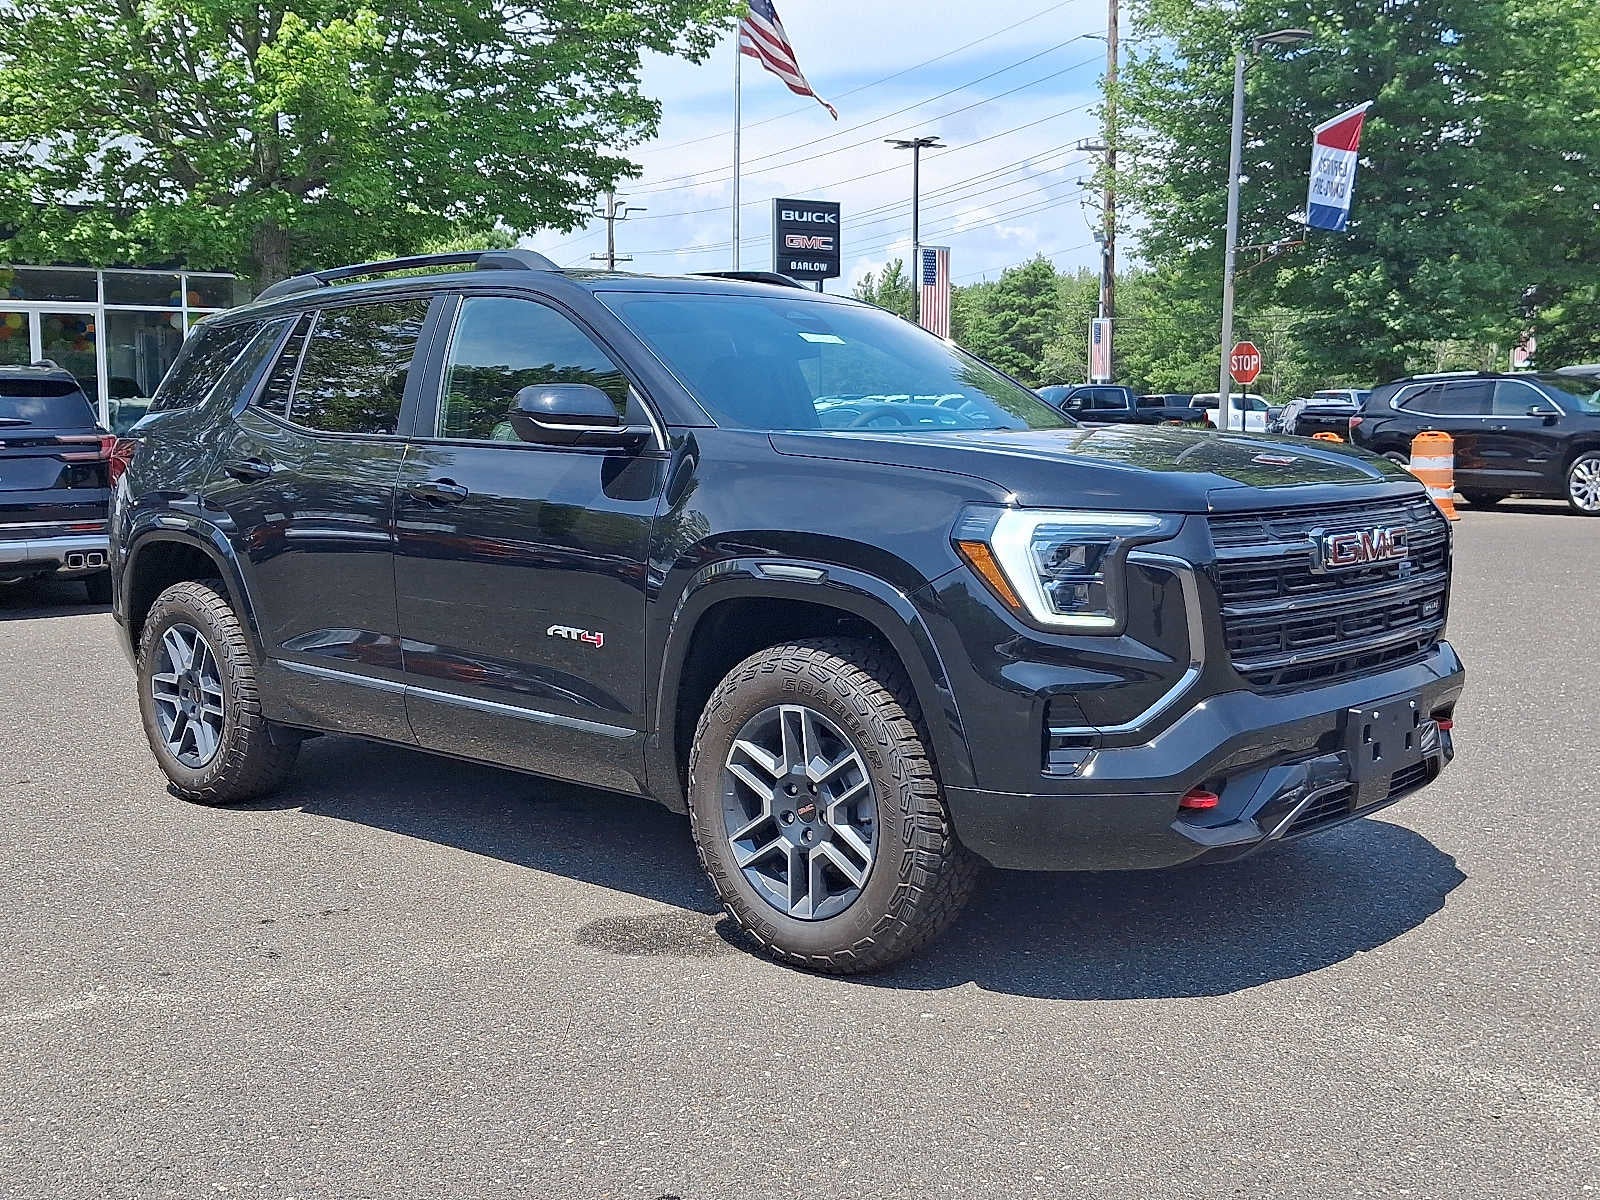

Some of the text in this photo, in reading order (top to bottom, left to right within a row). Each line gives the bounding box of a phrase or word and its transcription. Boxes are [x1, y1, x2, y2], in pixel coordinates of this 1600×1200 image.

[781, 210, 837, 224] BUICK
[785, 234, 833, 251] GMC
[790, 261, 828, 272] BARLOW
[1231, 354, 1259, 371] STOP
[1327, 526, 1409, 567] GMC
[546, 624, 604, 648] AT4
[782, 676, 883, 769] GRABBER
